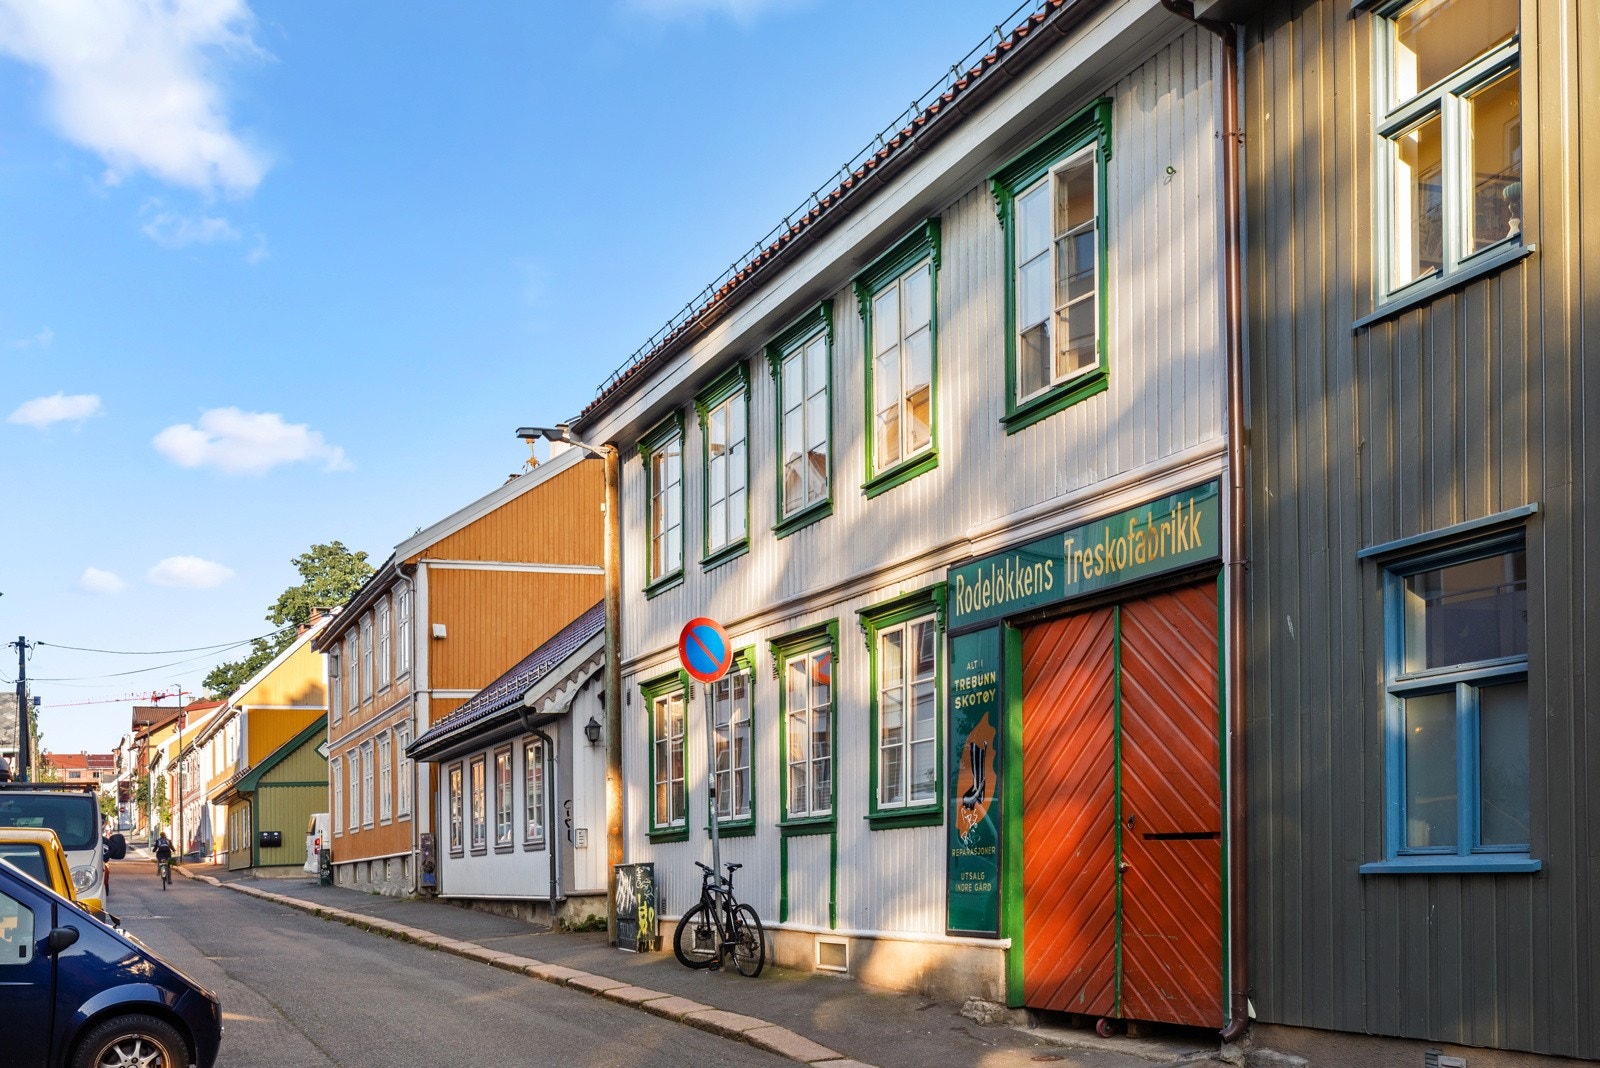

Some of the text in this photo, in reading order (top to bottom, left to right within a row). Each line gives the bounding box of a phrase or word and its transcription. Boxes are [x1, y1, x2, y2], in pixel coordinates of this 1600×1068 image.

[955, 497, 1202, 616] Rodelökkens Treskofabrikk
[966, 660, 978, 670] ALT
[954, 671, 996, 692] TREBUNN
[954, 688, 996, 709] SKOTØY
[951, 846, 996, 857] REPARASJONER
[960, 872, 985, 880] UTSALG
